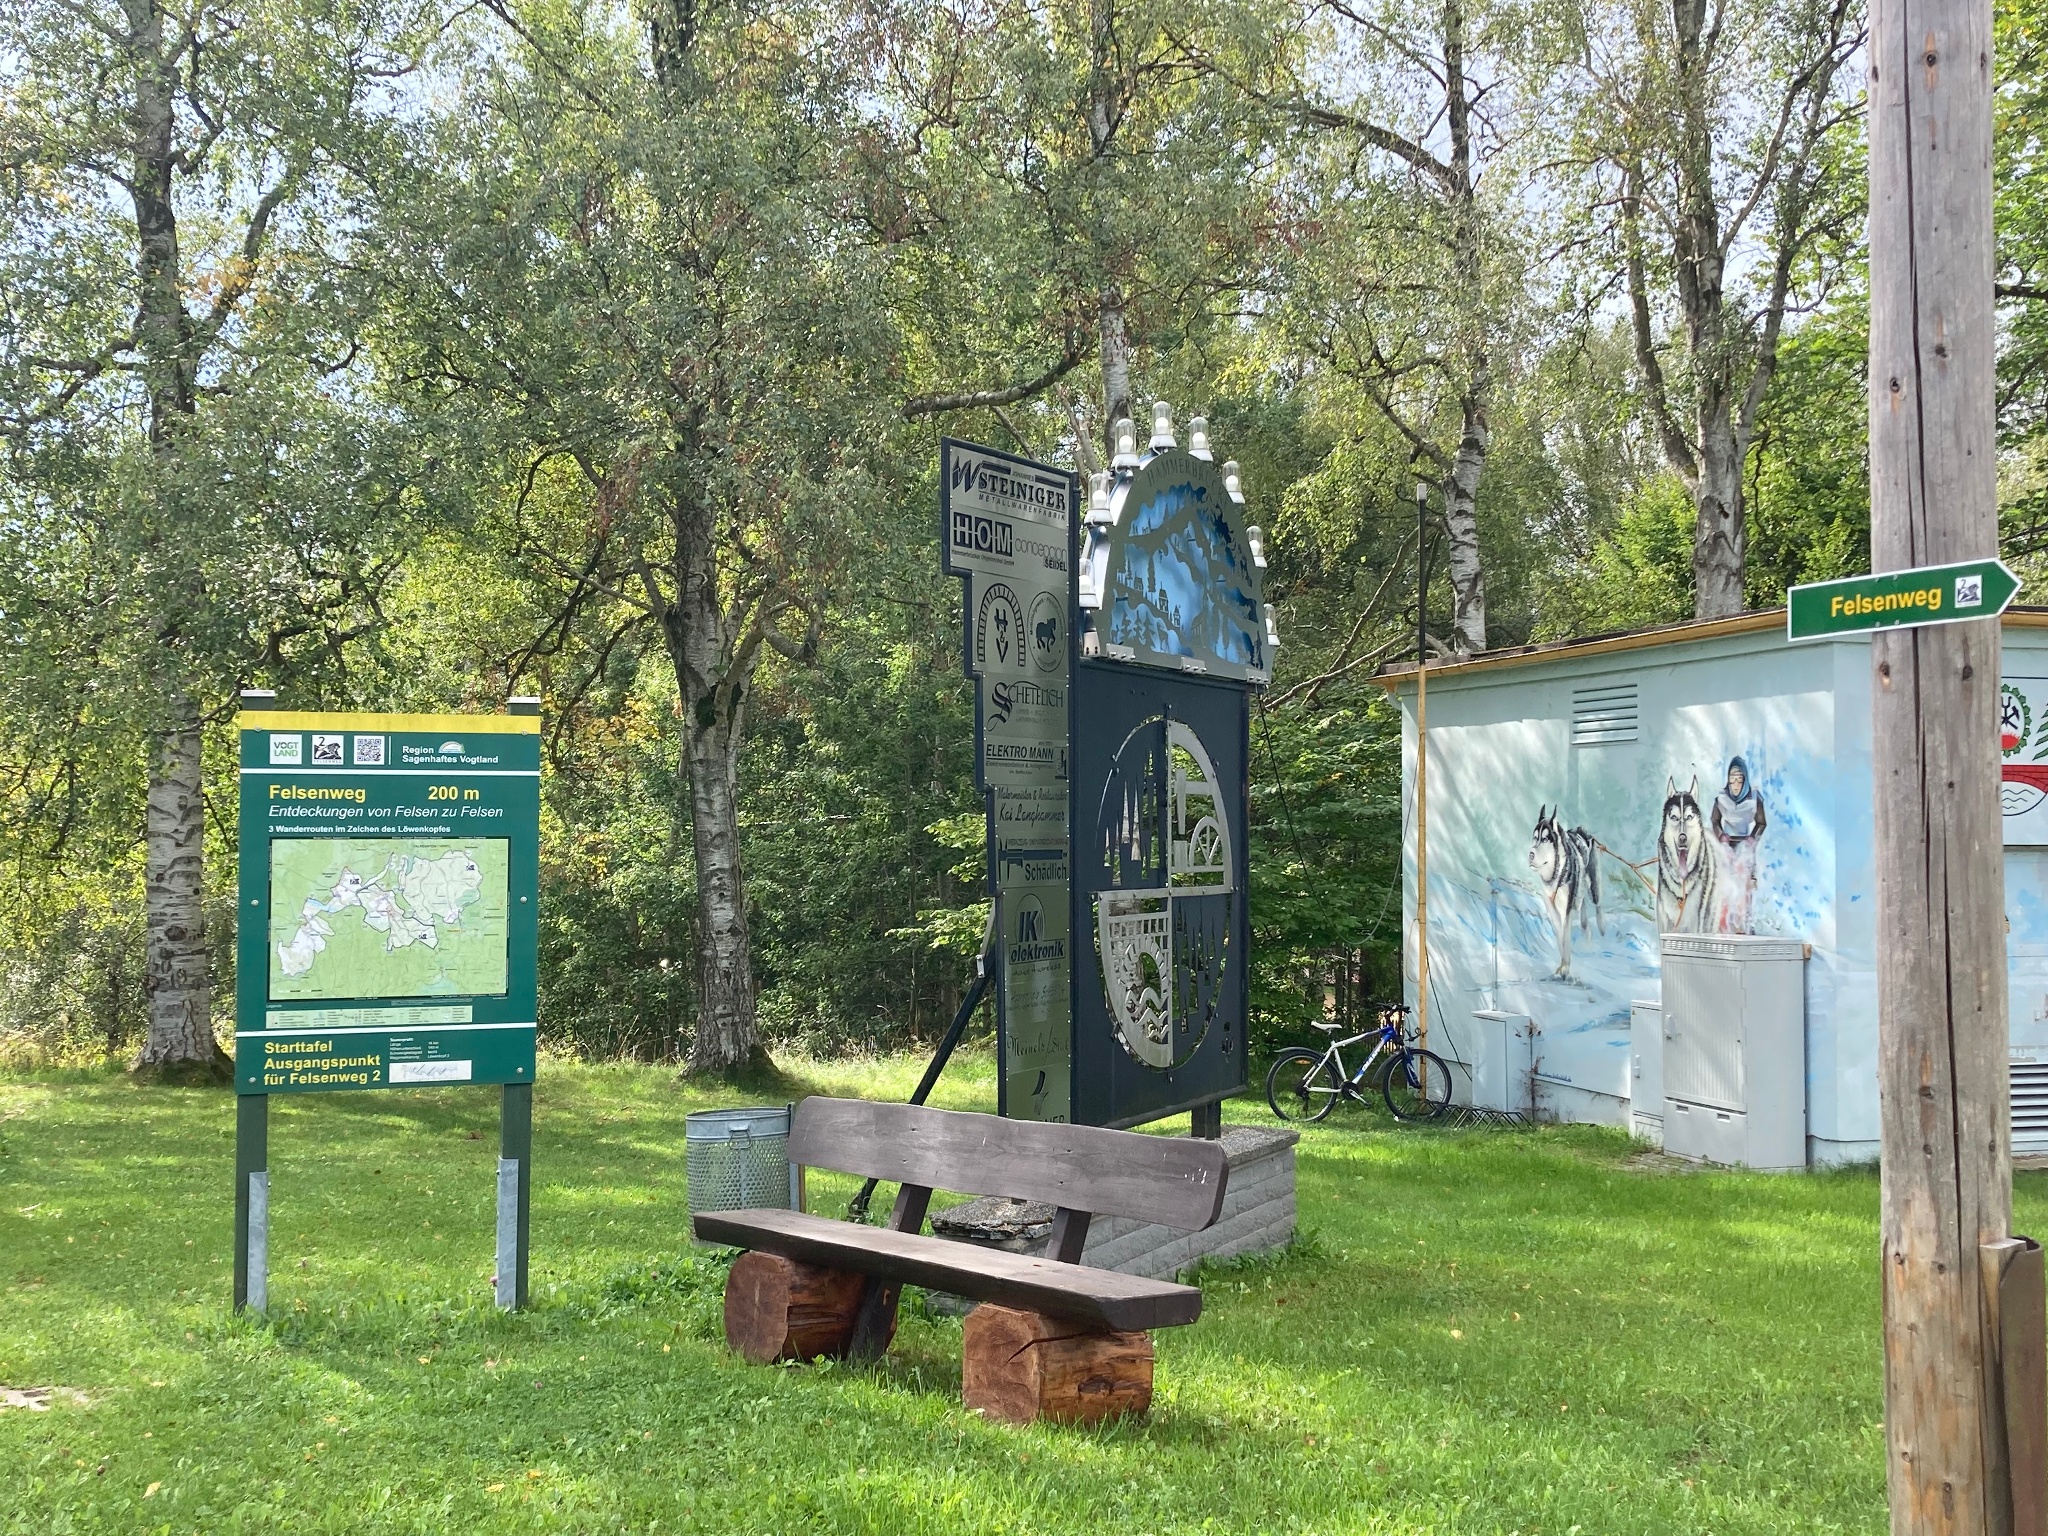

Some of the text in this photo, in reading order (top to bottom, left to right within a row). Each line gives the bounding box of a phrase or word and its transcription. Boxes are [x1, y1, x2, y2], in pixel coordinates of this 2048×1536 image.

[978, 472, 1066, 511] STEINIGER
[979, 494, 1065, 521] METALLWARENFABRIK
[953, 511, 1013, 557] HOM
[1044, 558, 1067, 571] SEIDEL
[1831, 588, 1942, 617] Felsenweg
[273, 741, 299, 750] VOGT
[319, 736, 325, 746] 2
[273, 749, 299, 757] LAND
[402, 745, 434, 755] Region
[986, 744, 1054, 760] ELEKTRO MANN
[402, 754, 499, 765] Sagenhaftes Vogtland
[269, 785, 480, 803] Felsenweg 200 m
[269, 805, 503, 819] Entdeckungen von Felsen zu Felsen
[999, 802, 1012, 821] Kai
[268, 824, 451, 835] 3 Wanderrouten im Zeichen des Löwenkopfes
[1024, 863, 1067, 881] Schädlich
[1010, 941, 1064, 962] elektronik
[264, 1040, 333, 1054] Starttafel
[264, 1055, 381, 1071] Ausgangspunkt
[264, 1070, 381, 1085] für Felsenweg 2
